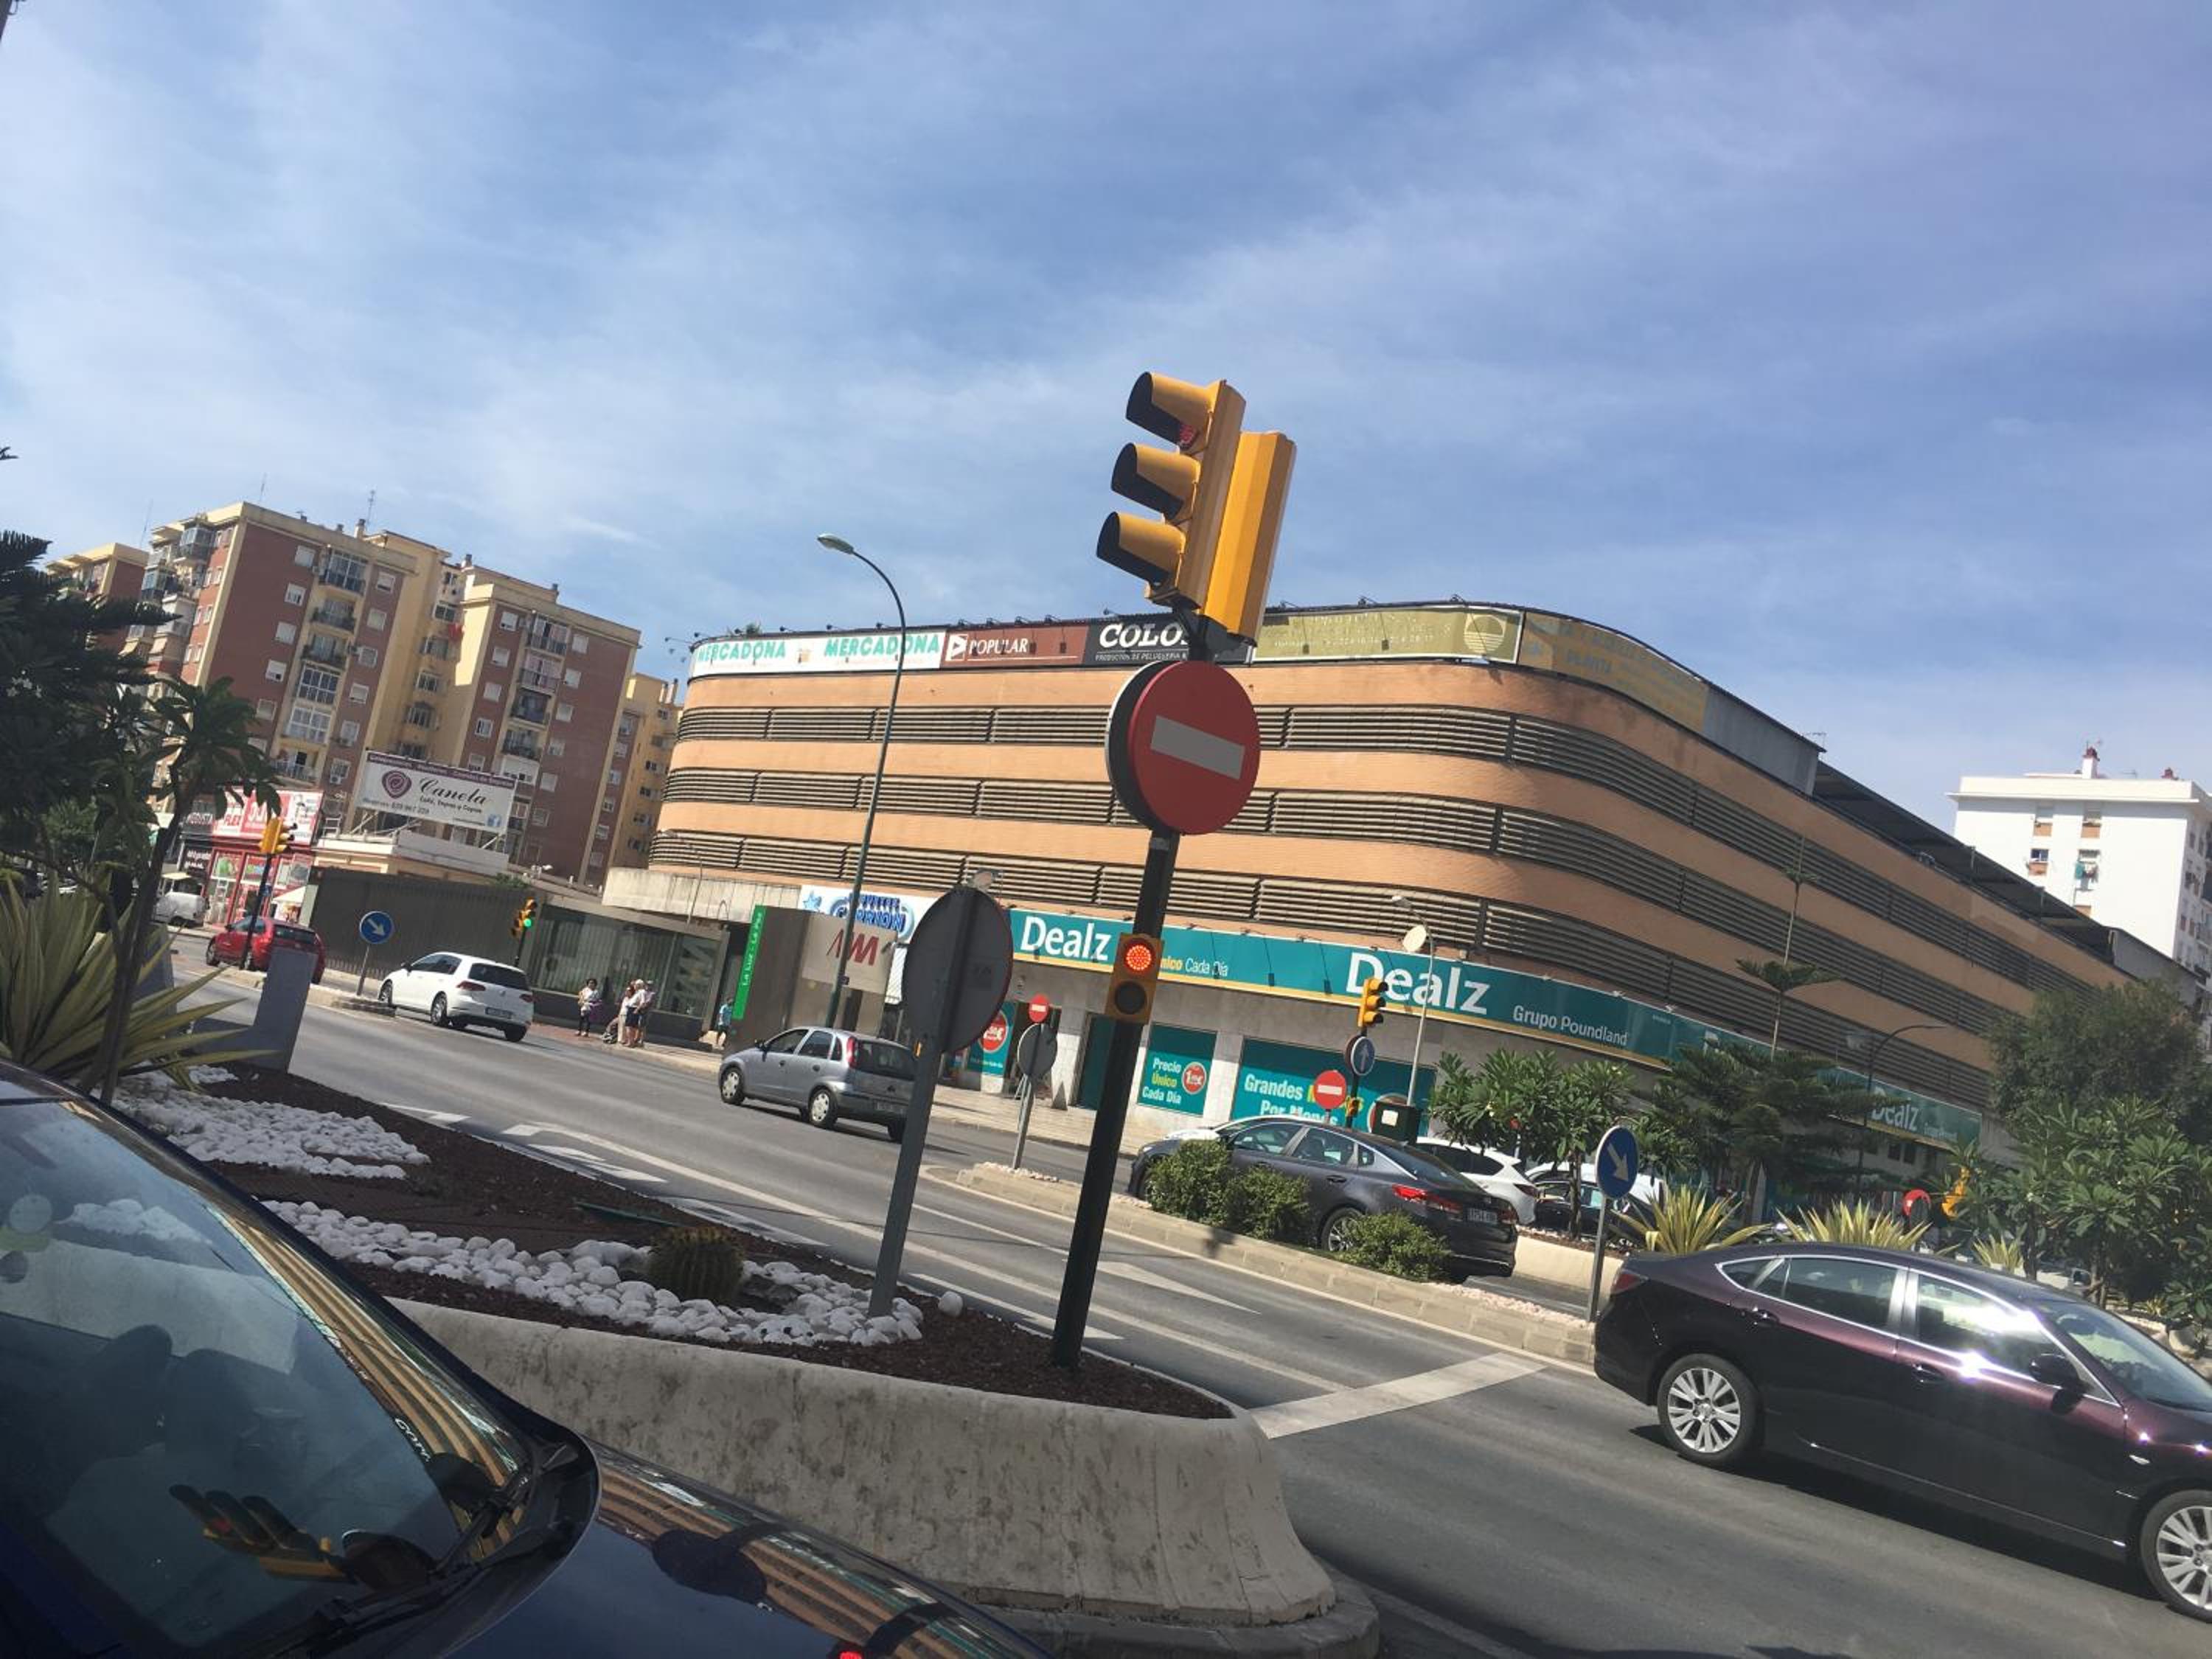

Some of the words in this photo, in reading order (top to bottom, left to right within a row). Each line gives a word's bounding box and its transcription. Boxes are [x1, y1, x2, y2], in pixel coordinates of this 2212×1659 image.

[824, 634, 939, 657] MERCADONA
[968, 638, 1029, 655] POPULAR
[1099, 622, 1188, 648] COLO
[698, 640, 786, 661] MERCADONA
[419, 776, 487, 805] Canela
[1020, 916, 1112, 961] Dealz
[1185, 957, 1210, 974] Cada
[1346, 953, 1490, 1015] Dealz
[1513, 1004, 1557, 1031] Grupo
[1560, 1015, 1628, 1046] Poundland
[1152, 1057, 1182, 1074] Precio
[1142, 1086, 1164, 1102] Cada
[1166, 1091, 1182, 1105] Día
[1244, 1074, 1304, 1101] Grandes
